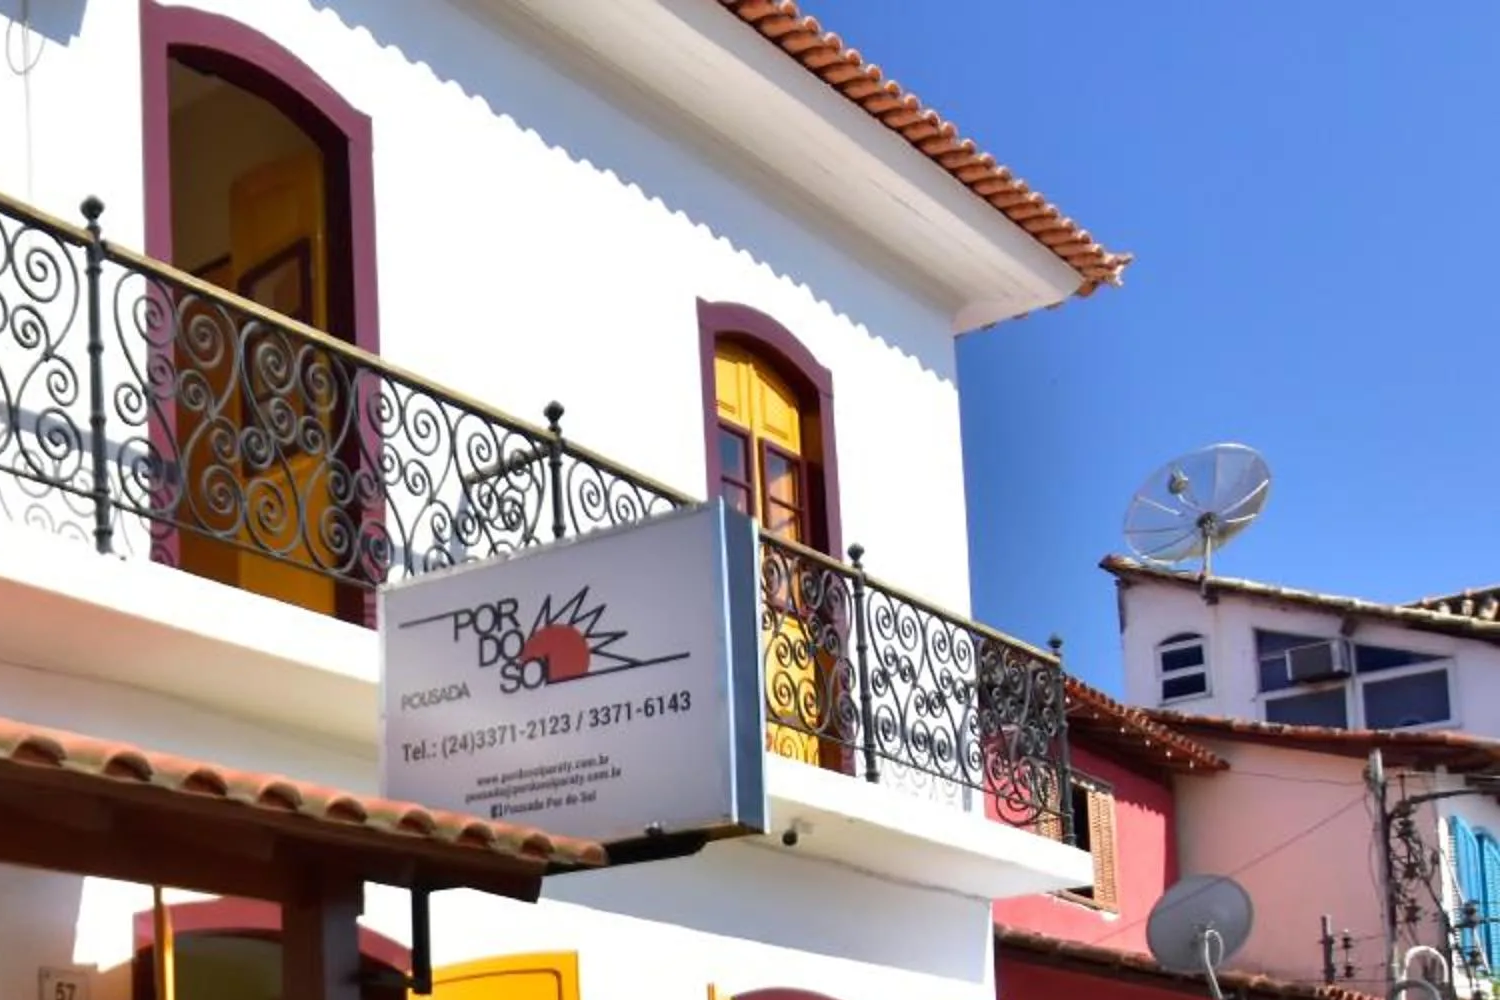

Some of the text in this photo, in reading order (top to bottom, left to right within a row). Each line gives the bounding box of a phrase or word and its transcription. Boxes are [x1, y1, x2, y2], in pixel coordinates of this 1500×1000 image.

[453, 598, 520, 642] POR
[479, 629, 525, 668] DO
[500, 655, 557, 693] SOL
[401, 682, 471, 710] POUSADA
[402, 738, 437, 763] Tel.:
[441, 714, 571, 759] (24)3371-2123
[589, 690, 692, 727] 3371-6143
